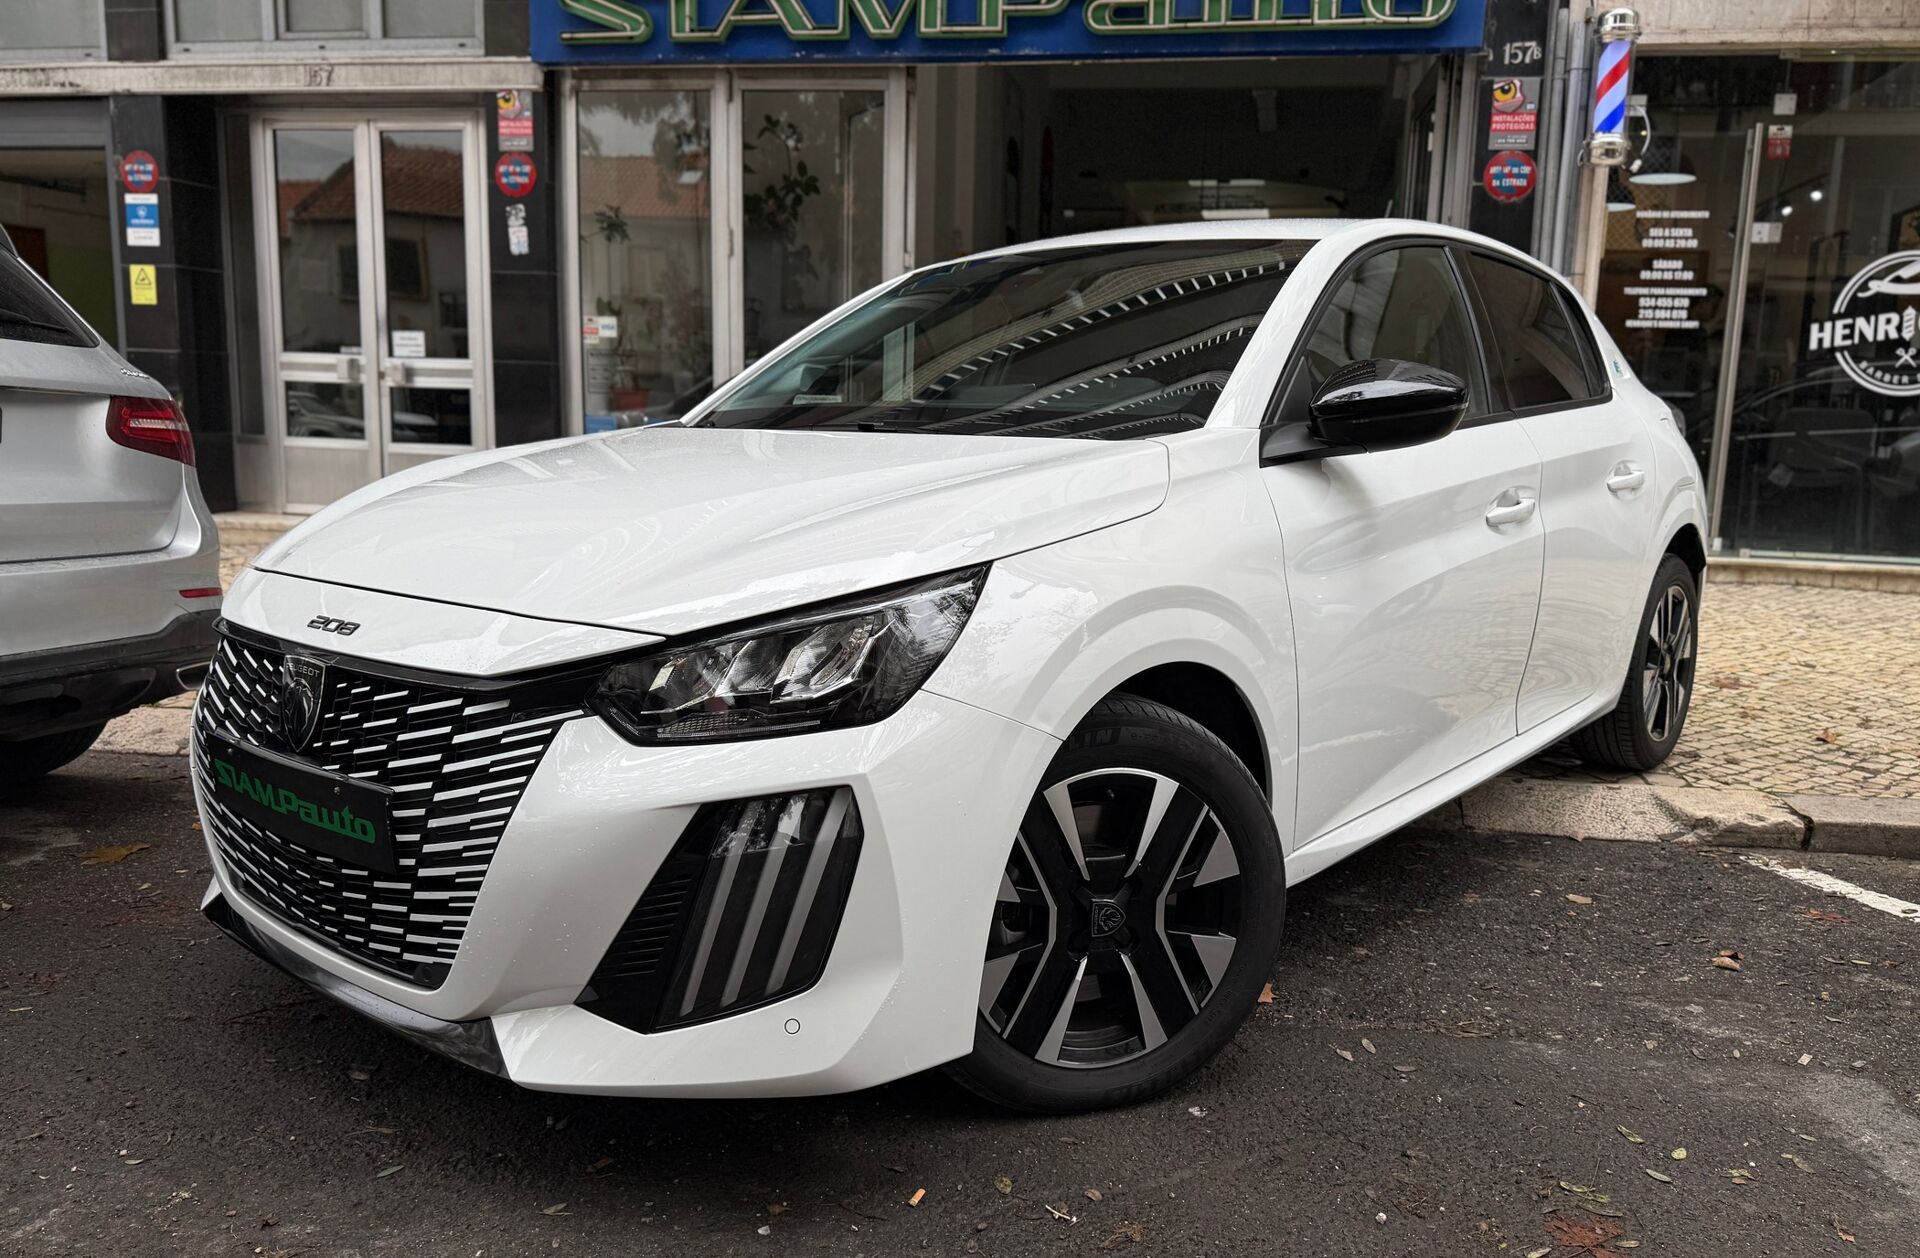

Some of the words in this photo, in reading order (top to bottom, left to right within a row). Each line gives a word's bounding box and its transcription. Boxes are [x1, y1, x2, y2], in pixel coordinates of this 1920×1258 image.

[1492, 113, 1535, 123] INSTALAÇÕES
[1491, 122, 1534, 131] PROTEGIDAS
[1502, 178, 1527, 187] ESTRADA
[307, 615, 361, 636] 208
[286, 662, 321, 678] PEUGEOT
